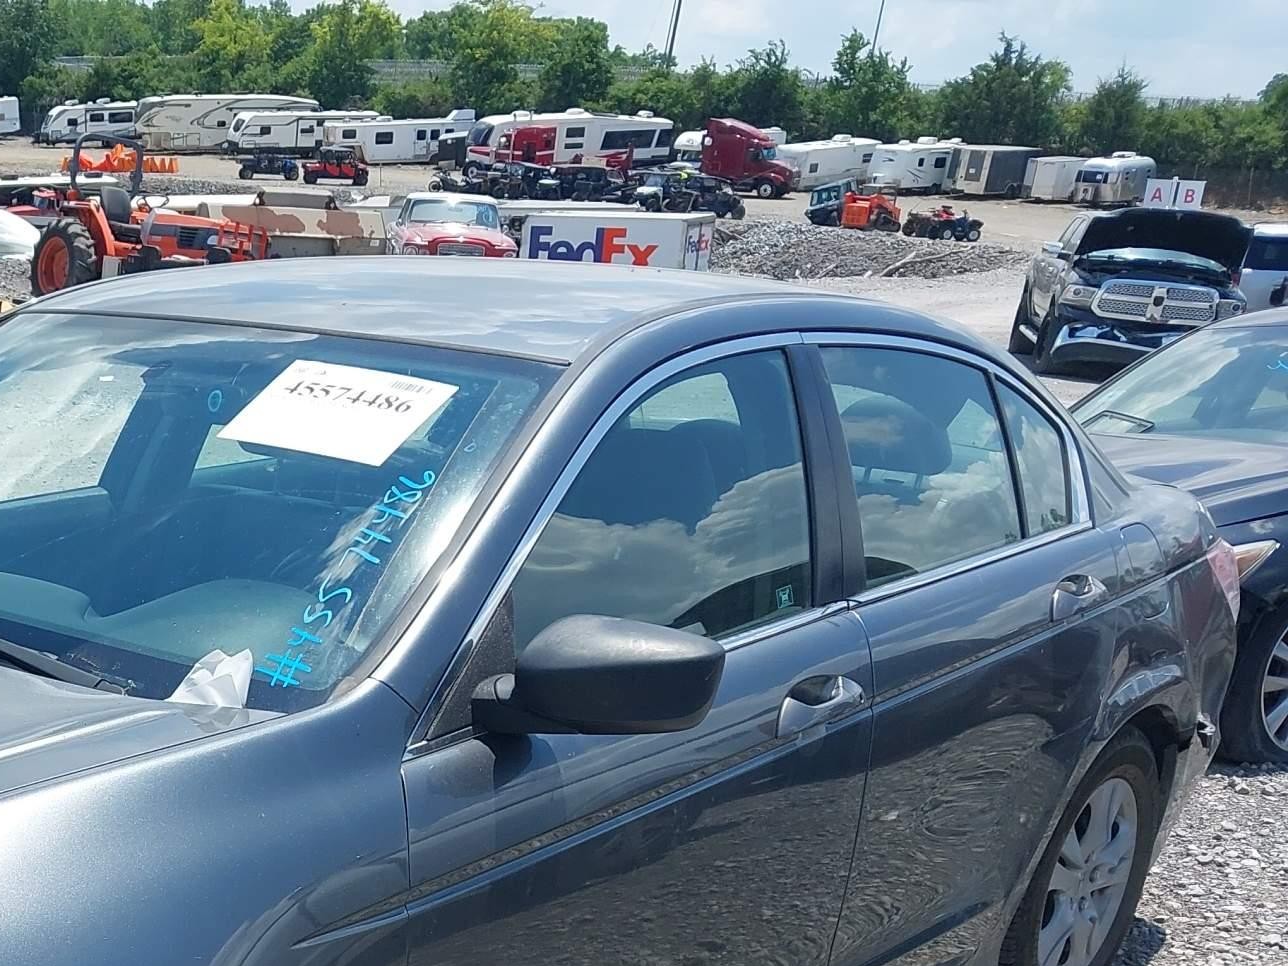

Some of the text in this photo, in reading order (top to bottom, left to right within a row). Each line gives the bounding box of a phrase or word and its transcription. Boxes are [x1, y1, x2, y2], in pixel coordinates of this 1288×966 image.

[1150, 187, 1163, 203] A
[1184, 189, 1196, 204] B
[528, 225, 659, 267] FedEx
[284, 380, 415, 413] 45574486
